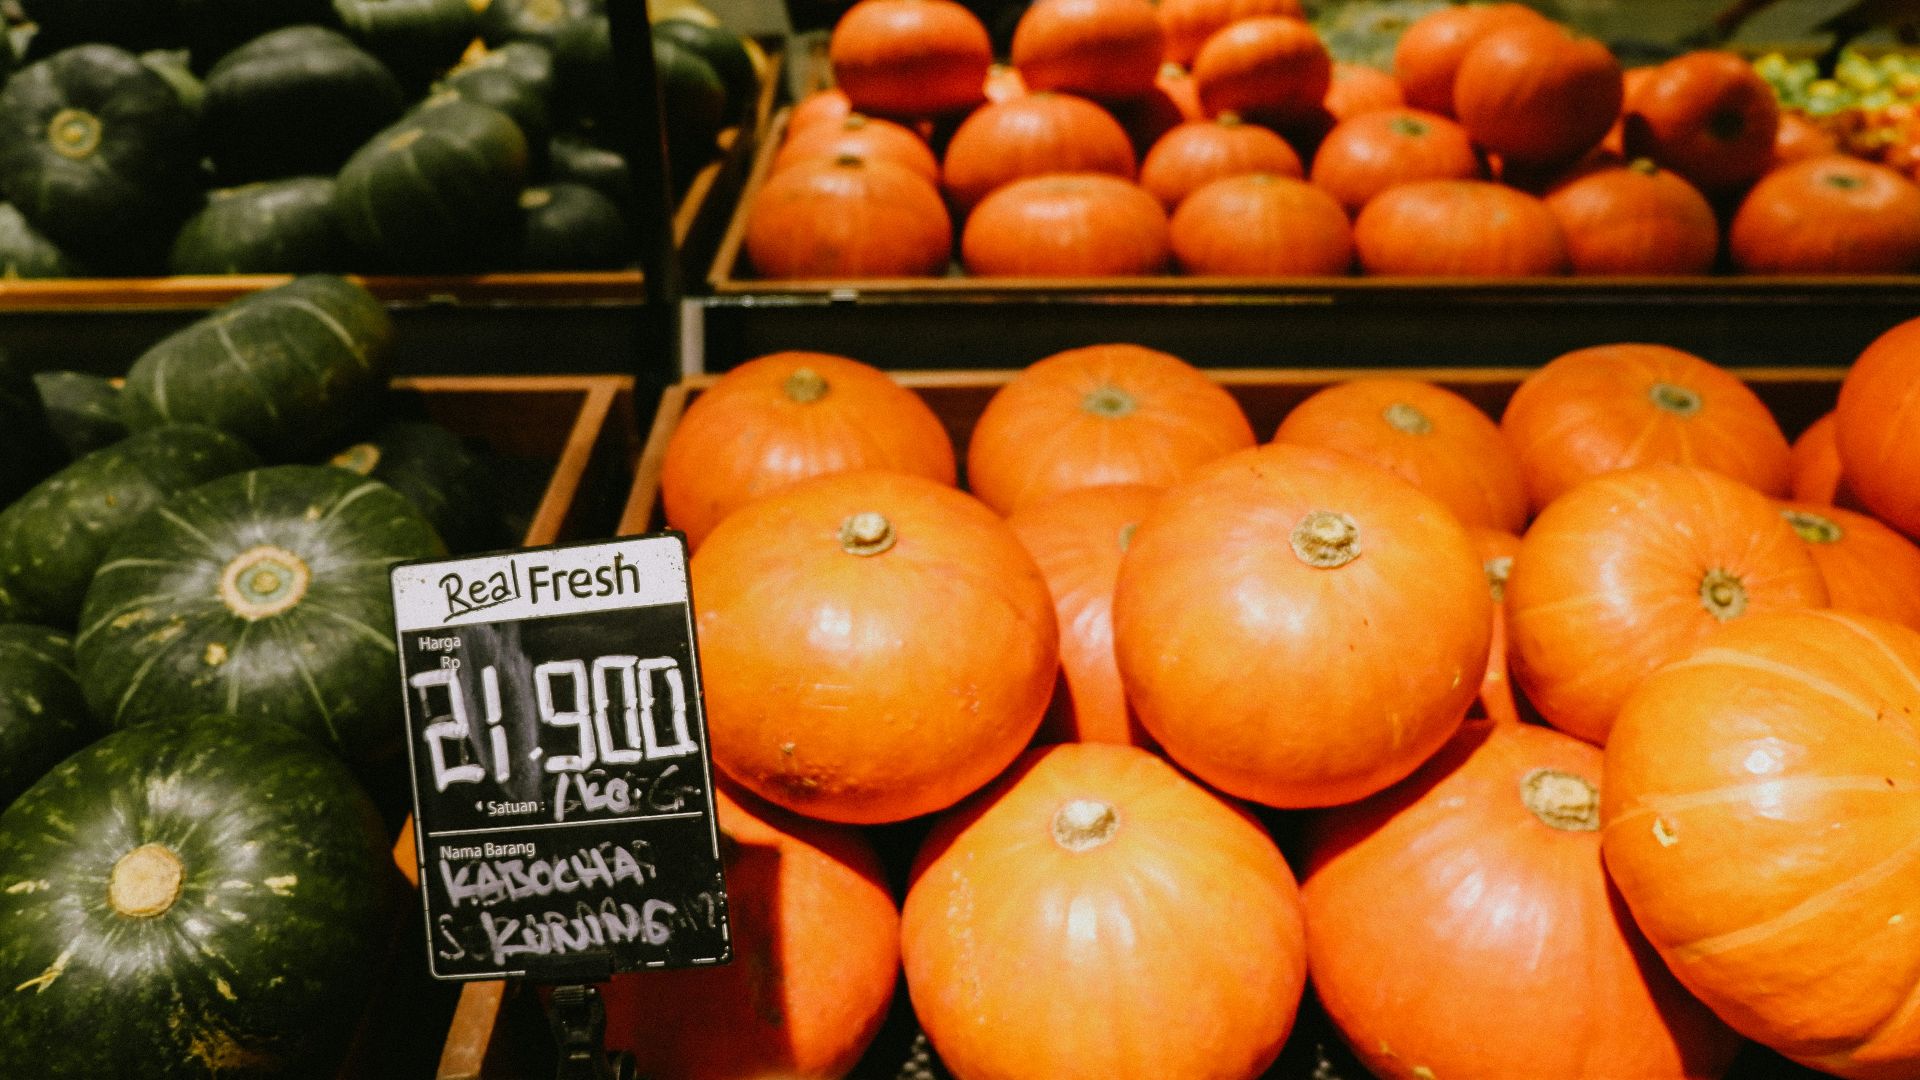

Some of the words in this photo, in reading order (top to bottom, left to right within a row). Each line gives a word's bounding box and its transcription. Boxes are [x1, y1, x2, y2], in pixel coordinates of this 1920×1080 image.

[439, 559, 520, 616] Real
[528, 552, 640, 604] Fresh
[418, 635, 461, 651] Harga
[440, 656, 461, 671] Rp
[487, 800, 538, 815] Satuan
[439, 845, 483, 859] Nama
[486, 842, 536, 859] Barang
[439, 846, 645, 908] KABOCHA
[480, 899, 678, 965] KUNING
